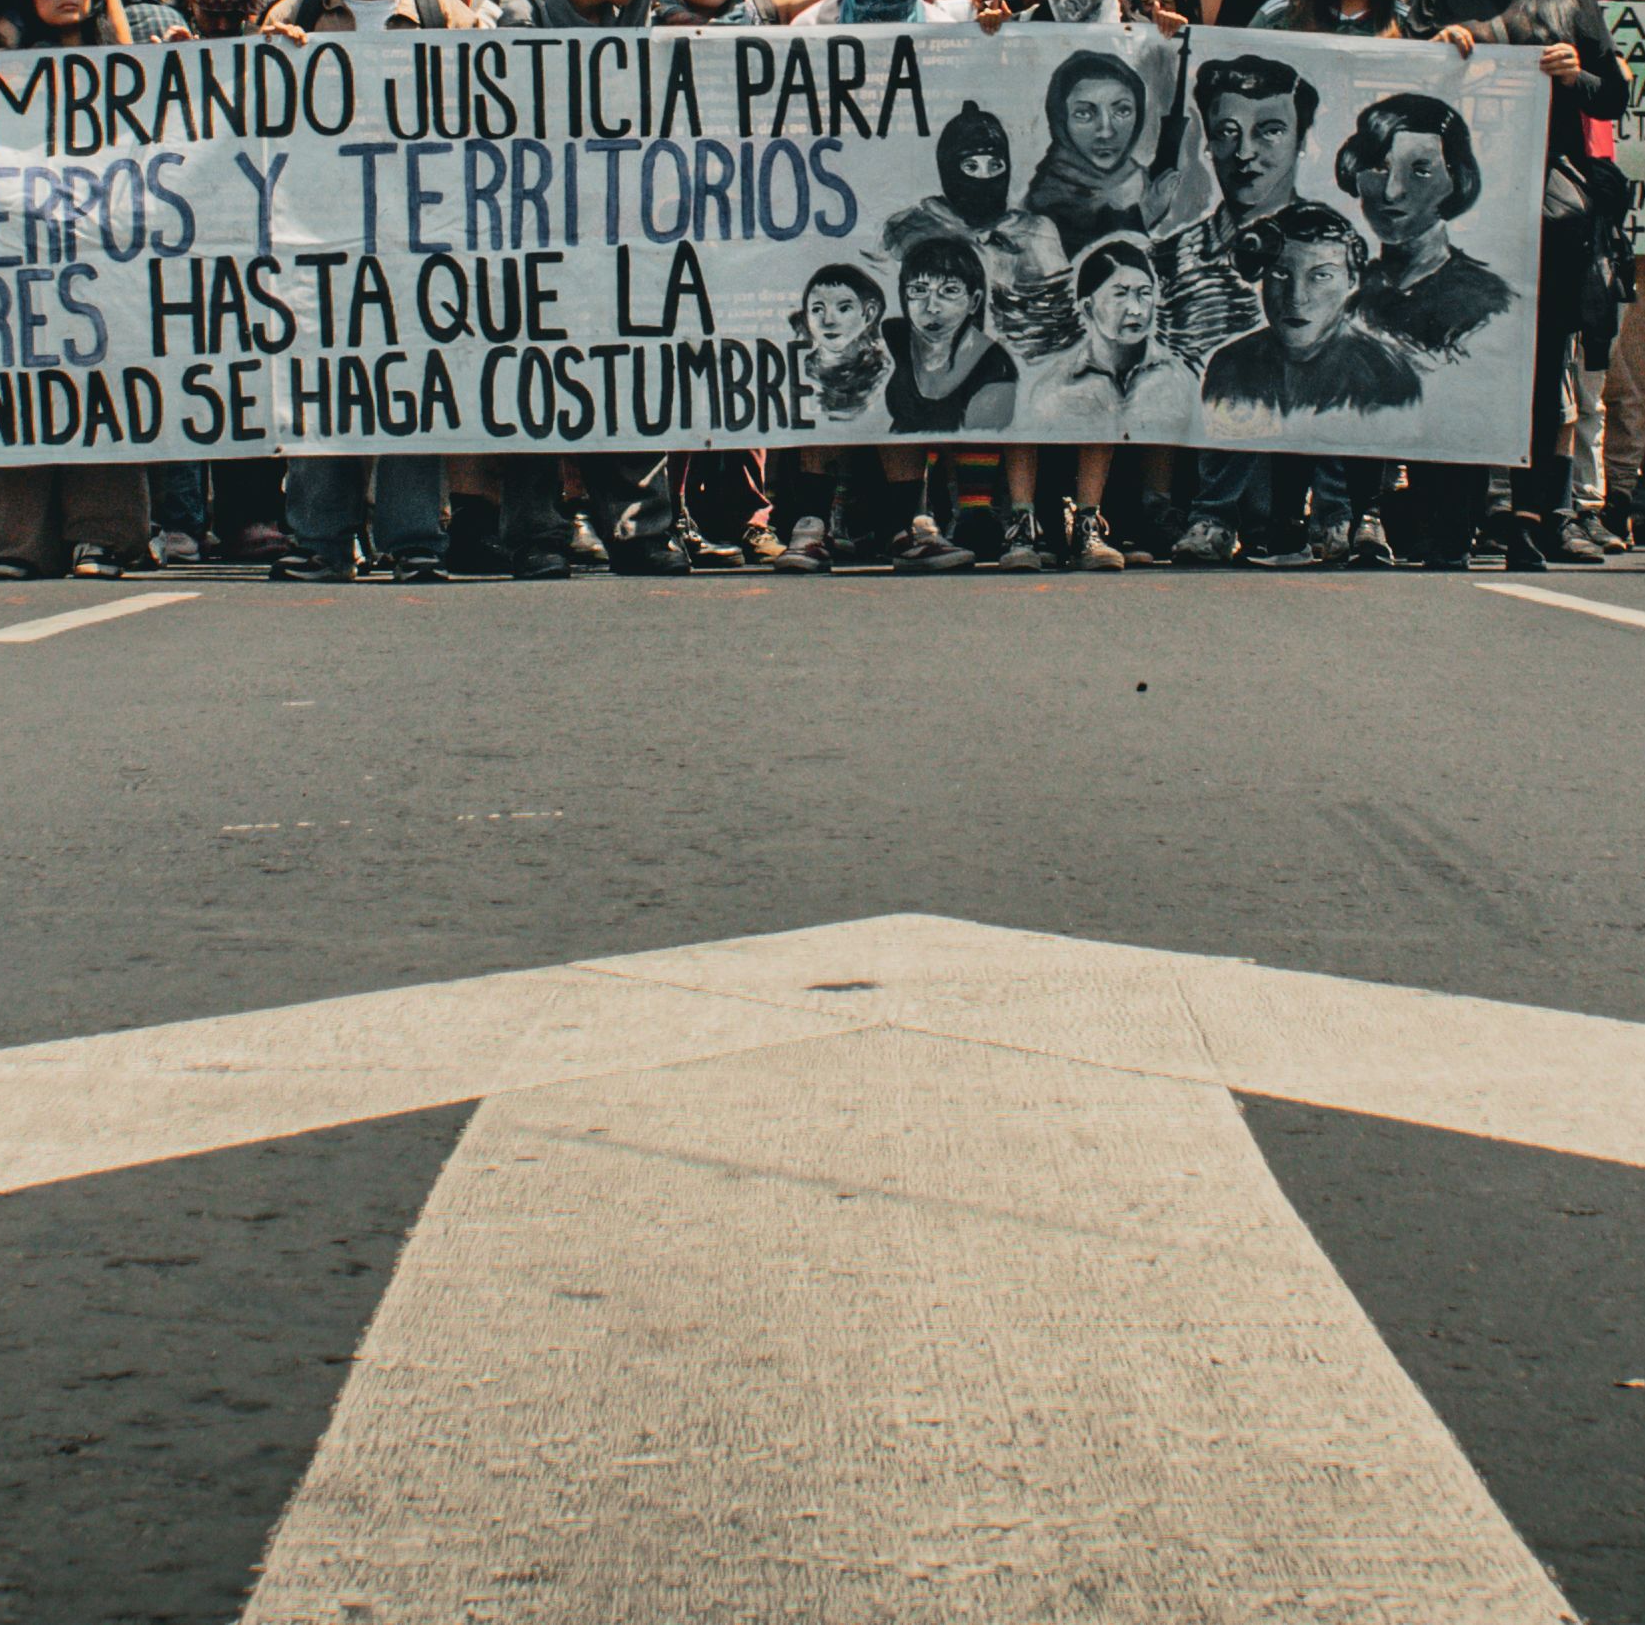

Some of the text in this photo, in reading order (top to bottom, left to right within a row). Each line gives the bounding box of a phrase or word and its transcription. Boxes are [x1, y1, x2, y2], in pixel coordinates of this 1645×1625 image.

[385, 34, 703, 143] JUSTICIA
[735, 34, 934, 140] PARA
[234, 151, 293, 257] Y
[339, 136, 859, 257] TERRITORIOS
[149, 252, 407, 359] HASTA
[416, 252, 567, 343] QUE
[616, 239, 715, 339] LA
[181, 363, 266, 446] SE
[291, 346, 460, 439] HAGA
[479, 339, 816, 441] COSTUMBRE
